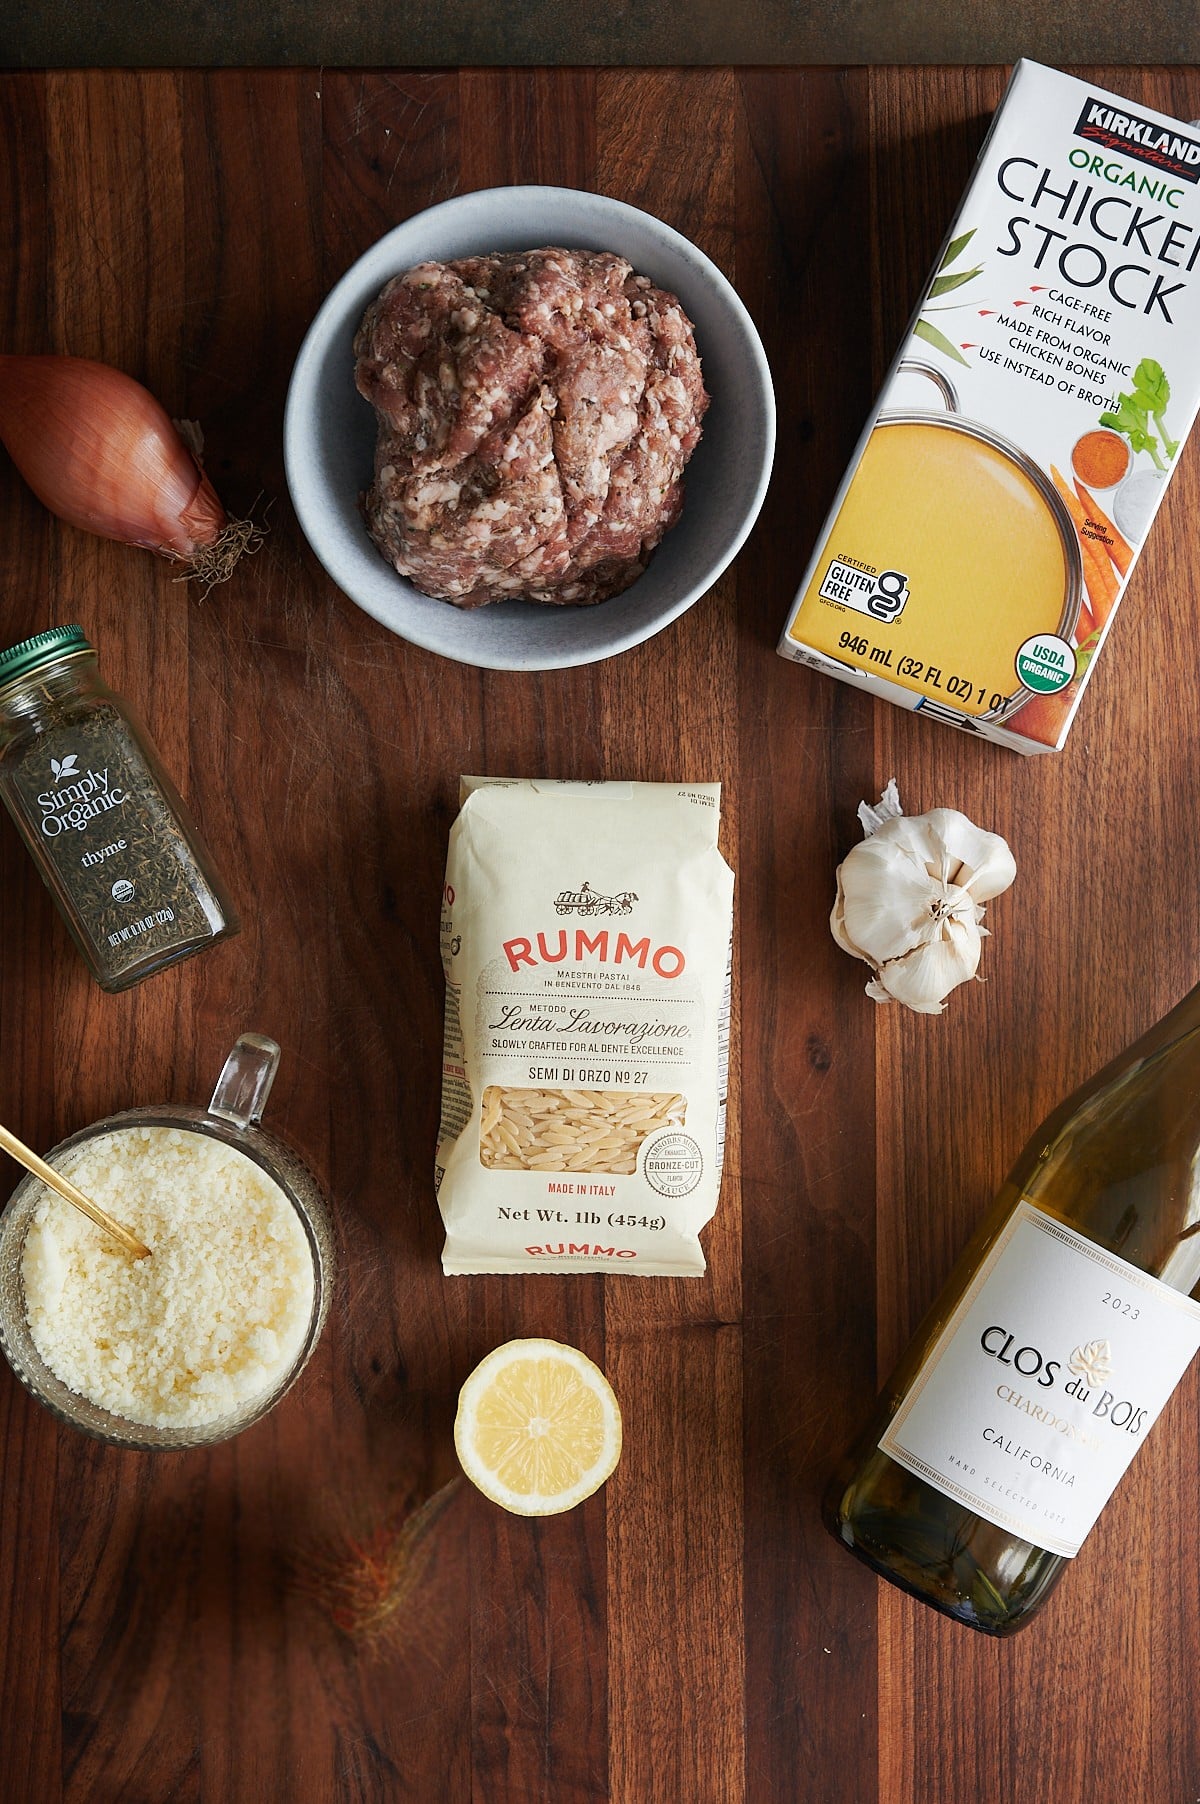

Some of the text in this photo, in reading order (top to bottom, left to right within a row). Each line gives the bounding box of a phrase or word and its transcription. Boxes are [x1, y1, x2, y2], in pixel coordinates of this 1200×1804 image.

[1087, 104, 1200, 165] KIRKLAND
[1080, 126, 1196, 177] Signature
[1069, 149, 1184, 208] ORGANIC
[996, 216, 1186, 324] STOCK
[1048, 289, 1112, 323] CAGE-FREE
[1032, 305, 1111, 346] RICH FLAVOR
[997, 314, 1132, 377] MADE FROM ORGANIC
[1008, 337, 1107, 385] CHICKEN BONES
[979, 346, 1121, 414] USE INSTEAD OF BROTH
[1081, 527, 1114, 545] Suggestion
[1084, 518, 1107, 534] Serving
[837, 553, 876, 574] CERTIFIED
[824, 580, 852, 602] FREE
[831, 566, 876, 594] GLUTEN
[838, 631, 869, 656] 946
[869, 647, 893, 668] mL
[896, 655, 921, 679] (32
[924, 666, 942, 689] FL
[946, 676, 973, 702] OZ)
[978, 688, 986, 705] 1
[1033, 644, 1065, 667] USDA
[1022, 660, 1064, 684] ORGANIC
[37, 767, 108, 816] Simply
[41, 788, 125, 836] Organic
[81, 839, 127, 867] thyme
[107, 932, 121, 947] NET
[130, 920, 147, 936] 0.78
[145, 915, 155, 929] OZ
[155, 907, 175, 925] (22g)
[502, 929, 686, 979] RUMMO
[555, 981, 602, 989] BENEVENTO
[557, 971, 630, 981] MAESTRI PASTAI
[488, 1005, 556, 1032] Lenta
[529, 1004, 566, 1013] METODO
[491, 1039, 684, 1056] SLOWLY CRAFTED FOR AL DENTE EXCELLENCE
[528, 1067, 558, 1081] SEMI
[562, 1069, 574, 1081] DI
[579, 1070, 611, 1083] ORZO
[634, 1072, 648, 1085] 27
[649, 1160, 699, 1170] BRONZE-CUT
[548, 1183, 616, 1197] MADE IN ITALY
[659, 1183, 689, 1194] SAUCE
[497, 1207, 667, 1230] Net Wt. 1lb (454g)
[525, 1243, 637, 1258] RUMMO
[1102, 1292, 1141, 1320] 2023
[980, 1325, 1148, 1435] CLOS du BOIS
[982, 1427, 1076, 1488] CALIFORNIA
[948, 1455, 976, 1476] HAND
[984, 1477, 1038, 1511] SELECTED
